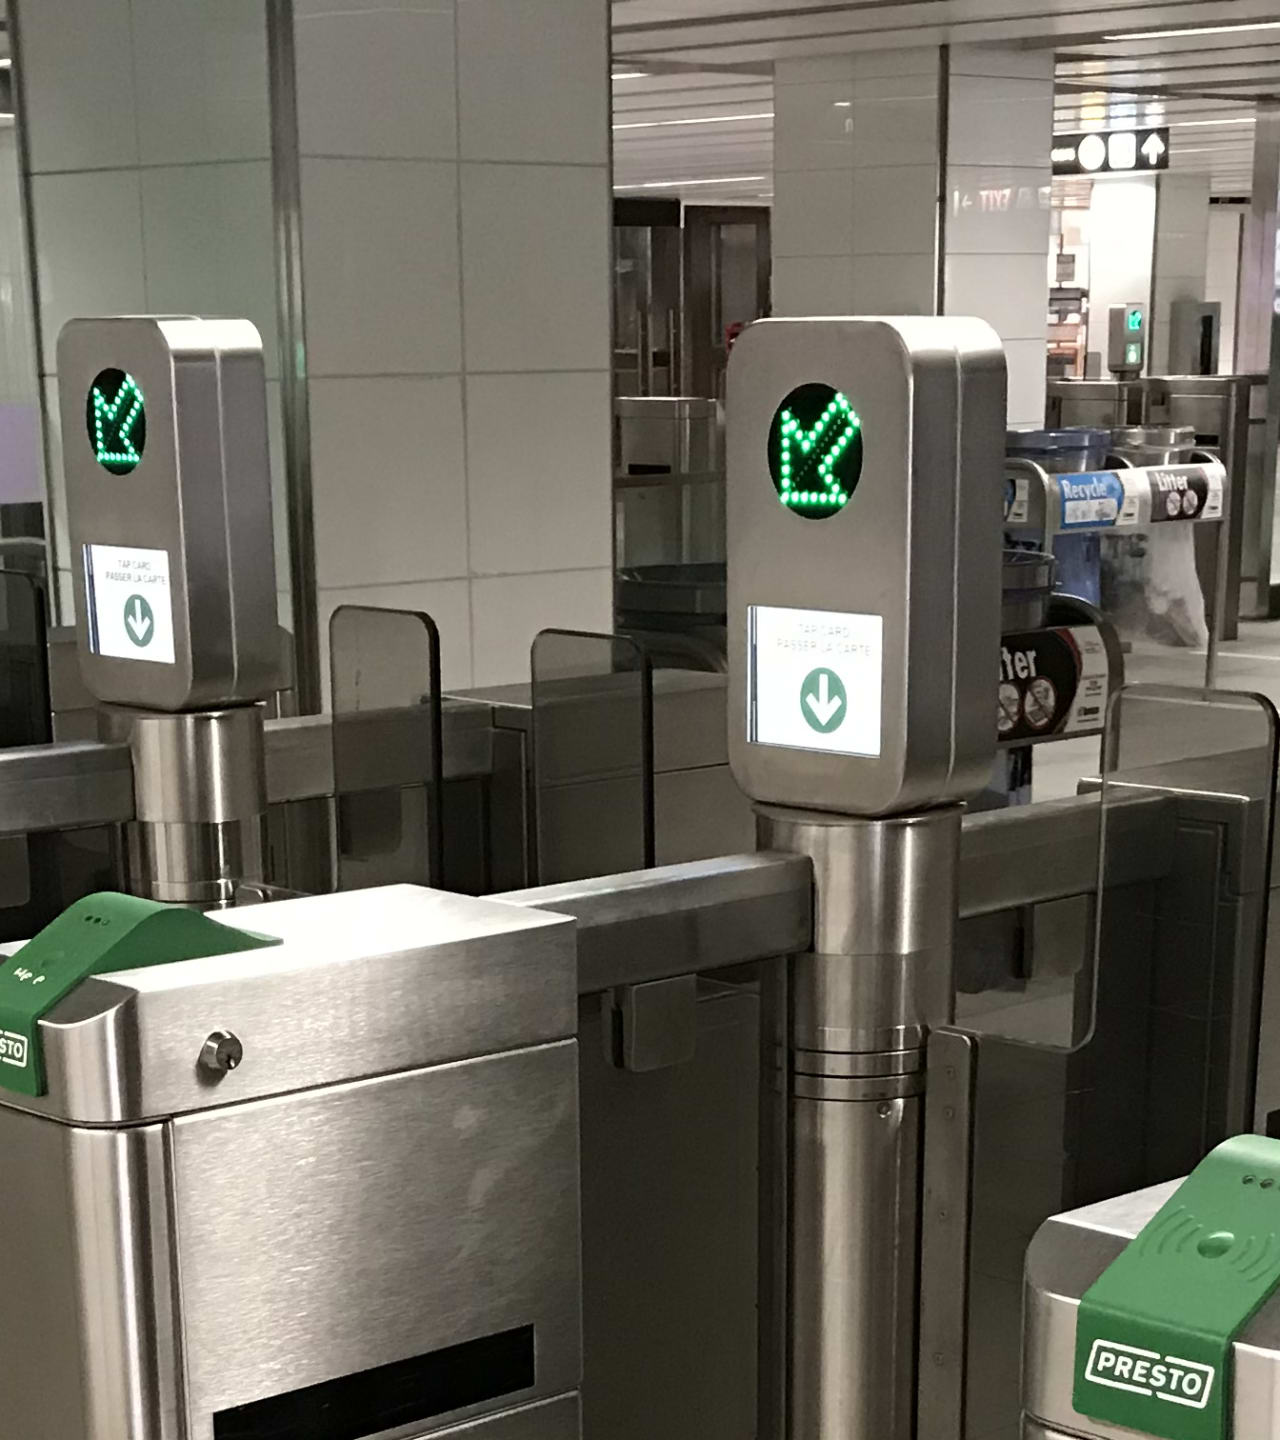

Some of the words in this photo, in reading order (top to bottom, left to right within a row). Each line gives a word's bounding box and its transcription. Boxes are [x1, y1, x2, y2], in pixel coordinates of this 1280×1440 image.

[1060, 476, 1107, 500] Recycle
[1154, 472, 1189, 492] Litter
[999, 646, 1037, 682] ter
[1097, 1351, 1202, 1396] PRESTO
